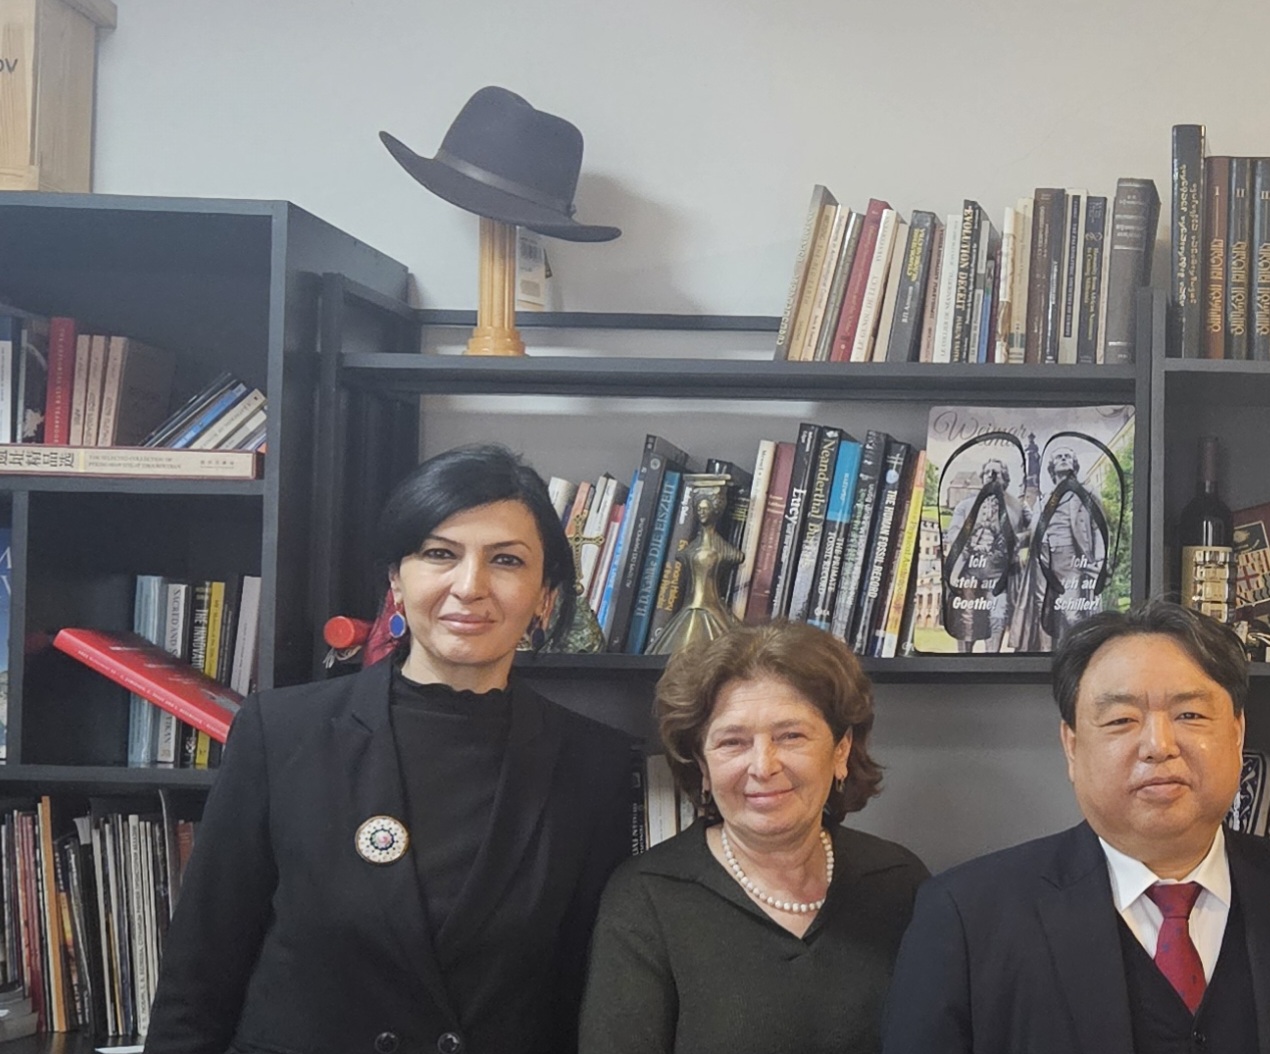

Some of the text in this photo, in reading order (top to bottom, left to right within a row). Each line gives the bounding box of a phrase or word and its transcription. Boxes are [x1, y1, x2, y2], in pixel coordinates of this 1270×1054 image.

[1235, 188, 1245, 198] II
[958, 208, 973, 268] EVOLUTION
[955, 271, 968, 311] DECEIT
[808, 437, 835, 518] Neanderthal
[654, 481, 674, 532] EISZEIT
[785, 486, 806, 525] Lucy
[648, 534, 663, 558] DIE
[867, 489, 897, 598] THE HUMAN FOSSIL RECORD
[902, 519, 917, 555] Physical
[818, 531, 835, 594] FOSSIL RECORD
[826, 536, 844, 592] THE PRIMATE
[968, 555, 987, 568] Ich
[1070, 555, 1088, 568] Ich
[980, 577, 997, 589] au
[1081, 576, 1097, 589] au
[169, 588, 181, 646] SACRED AND
[952, 596, 998, 610] Goethe!
[1054, 597, 1099, 611] Schiller!
